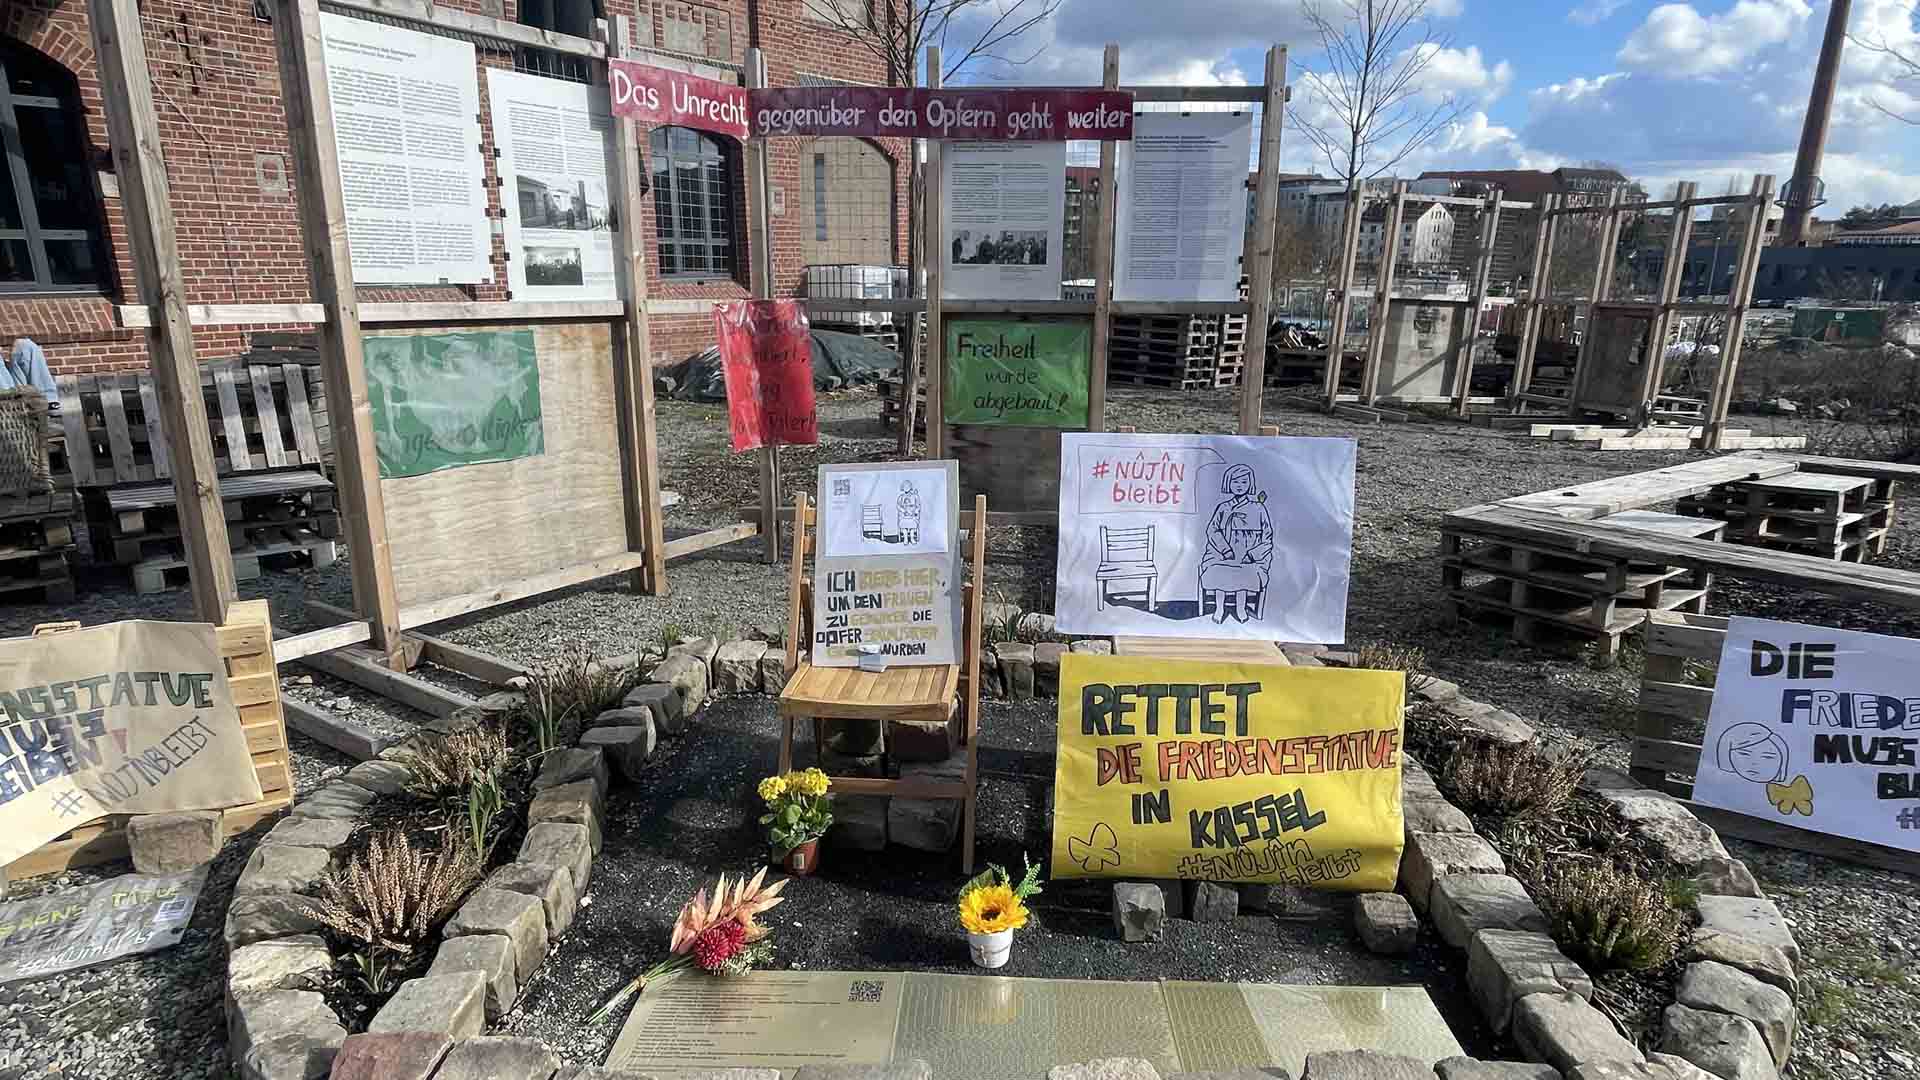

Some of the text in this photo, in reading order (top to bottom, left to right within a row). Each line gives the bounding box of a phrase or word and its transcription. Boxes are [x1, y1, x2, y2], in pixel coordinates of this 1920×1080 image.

[613, 68, 1132, 138] Das Unrecht gegenüber den Opfern geht weiter
[957, 333, 1036, 360] Freiheit
[985, 367, 1038, 384] wurde
[973, 391, 1069, 418] abgebaut!
[1112, 483, 1181, 504] bleibt
[827, 570, 856, 592] ICH
[827, 596, 851, 612] UM
[854, 593, 882, 609] DEN
[826, 615, 849, 629] ZU
[912, 609, 932, 622] DIE
[815, 628, 862, 647] OPFER
[1750, 639, 1836, 679] DIE
[1081, 681, 1262, 737] RETTET
[1096, 728, 1399, 786] DIE FRIEDENSSTATUE
[1131, 789, 1172, 825] IN
[1189, 788, 1327, 848] KASSEL
